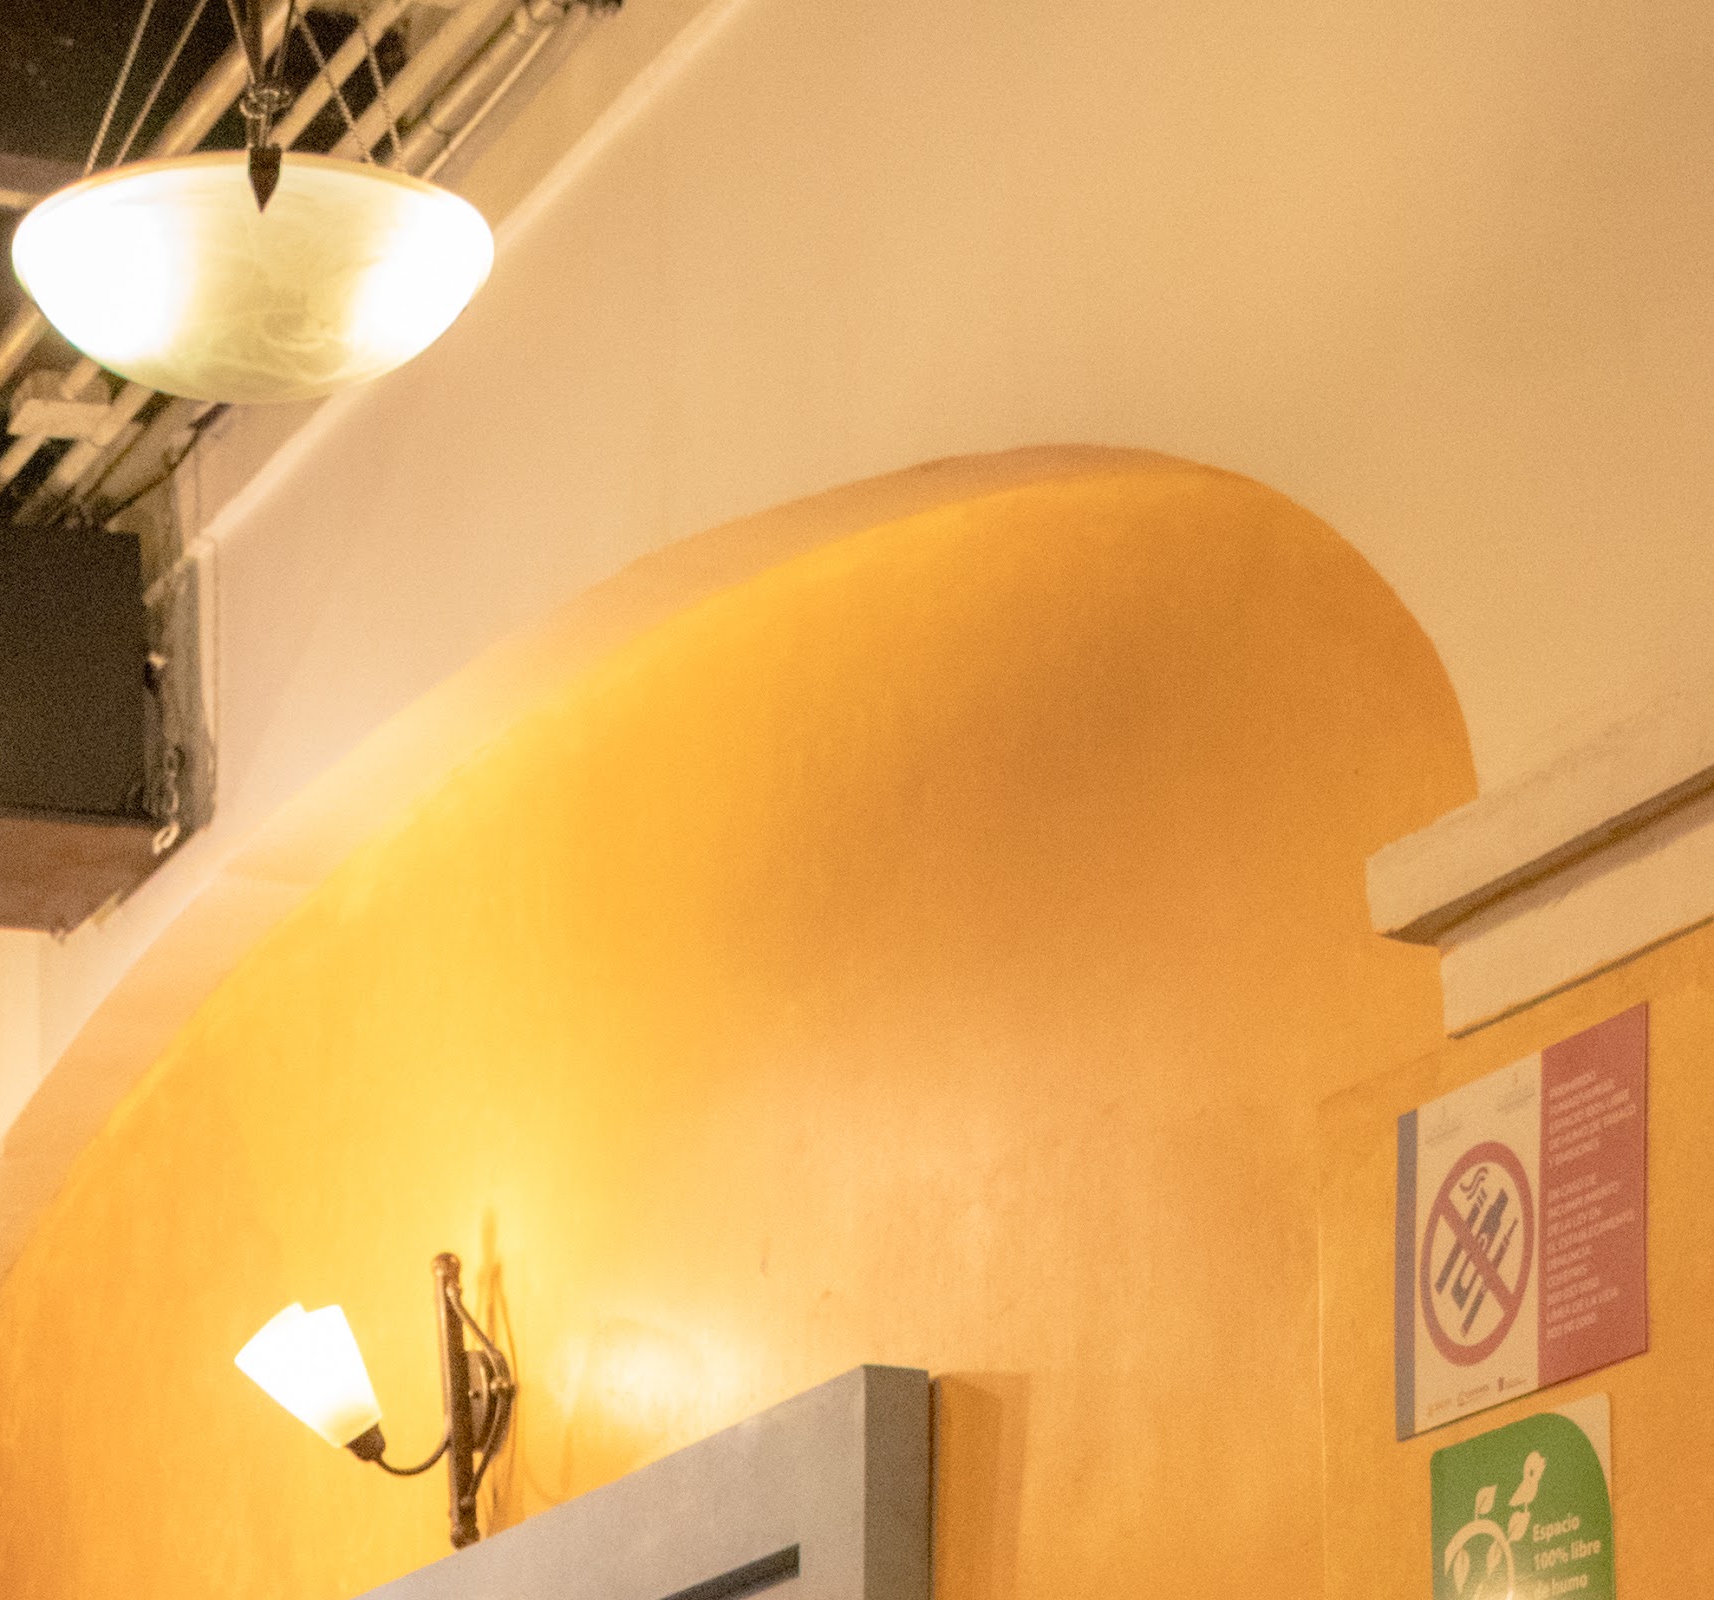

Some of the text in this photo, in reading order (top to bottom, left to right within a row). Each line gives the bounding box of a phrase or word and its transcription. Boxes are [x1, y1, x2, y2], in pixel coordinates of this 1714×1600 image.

[1532, 1515, 1582, 1543] Espacio
[1534, 1538, 1602, 1571] 100% libre
[1534, 1573, 1588, 1600] de humo
